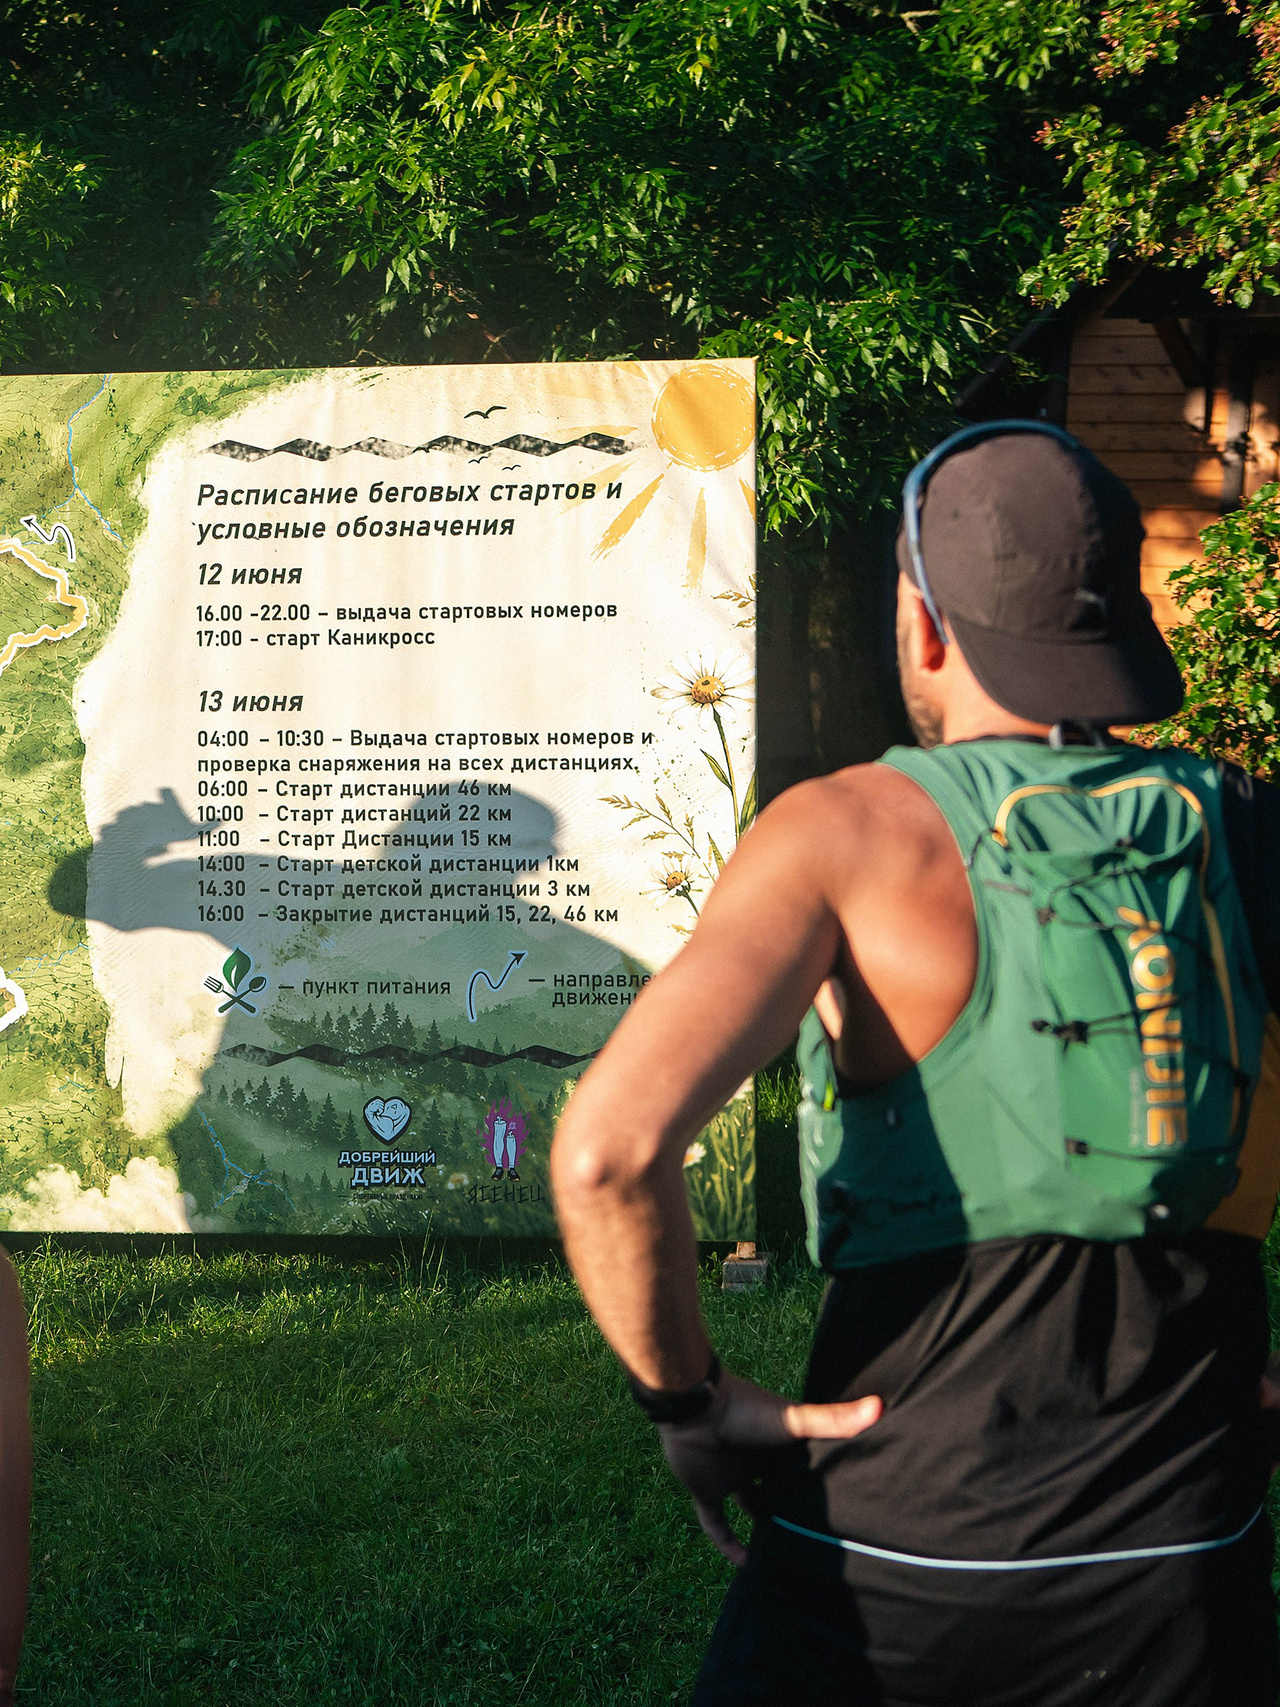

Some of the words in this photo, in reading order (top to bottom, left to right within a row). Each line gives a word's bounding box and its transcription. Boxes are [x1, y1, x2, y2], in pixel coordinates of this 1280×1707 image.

[198, 483, 357, 505] Расписание
[369, 480, 480, 503] беговых
[491, 482, 596, 504] стартов
[607, 482, 622, 499] и
[197, 521, 325, 545] условные
[337, 515, 514, 537] обозначения
[199, 562, 222, 585] 12
[232, 567, 302, 584] июня
[197, 604, 242, 621] 16.00
[337, 606, 410, 622] выдача
[419, 605, 523, 623] стартовых
[532, 604, 617, 621] номеров
[197, 629, 241, 646] 17:00
[267, 633, 320, 650] старт
[329, 628, 435, 648] Каникросс
[200, 690, 223, 712] 13
[233, 695, 303, 711] июня
[198, 729, 248, 747] 04:00
[277, 729, 323, 746] 10:30
[351, 729, 426, 748] Выдача
[435, 732, 539, 749] стартовых
[548, 732, 634, 749] номеров
[642, 731, 654, 744] и
[198, 759, 290, 776] проверка
[299, 758, 419, 775] снаряжения
[429, 758, 450, 770] на
[460, 758, 503, 770] всех
[199, 779, 247, 796] 06:00
[276, 779, 332, 800] Старт
[340, 783, 449, 799] дистанции
[458, 779, 479, 796] 46
[488, 783, 511, 796] км
[198, 804, 243, 824] 10:00
[277, 804, 333, 825] Старт
[342, 802, 450, 824] дистанций
[458, 803, 480, 821] 22
[488, 808, 511, 821] км
[198, 828, 239, 846] 11:00
[279, 829, 334, 850] Старт
[342, 829, 453, 849] Дистанции
[461, 829, 479, 846] 15
[488, 833, 511, 846] км
[198, 854, 244, 872] 14:00
[278, 854, 334, 876] Старт
[342, 853, 421, 874] детской
[429, 858, 539, 874] дистанции
[198, 879, 245, 896] 14.30
[278, 879, 334, 900] Старт
[341, 877, 422, 899] детской
[430, 883, 539, 899] дистанции
[548, 879, 558, 896] 3
[567, 883, 589, 896] км
[199, 904, 244, 921] 16:00
[277, 904, 372, 927] Закрытие
[380, 903, 489, 924] дистанций
[497, 904, 521, 924] 15,
[529, 904, 556, 924] 22,
[564, 905, 586, 921] 46
[595, 909, 617, 921] км
[303, 978, 359, 998] пункт
[368, 981, 450, 994] питания
[338, 1147, 437, 1165] ДОБРЕЙШИЙ
[351, 1167, 426, 1187] ДВИЖ
